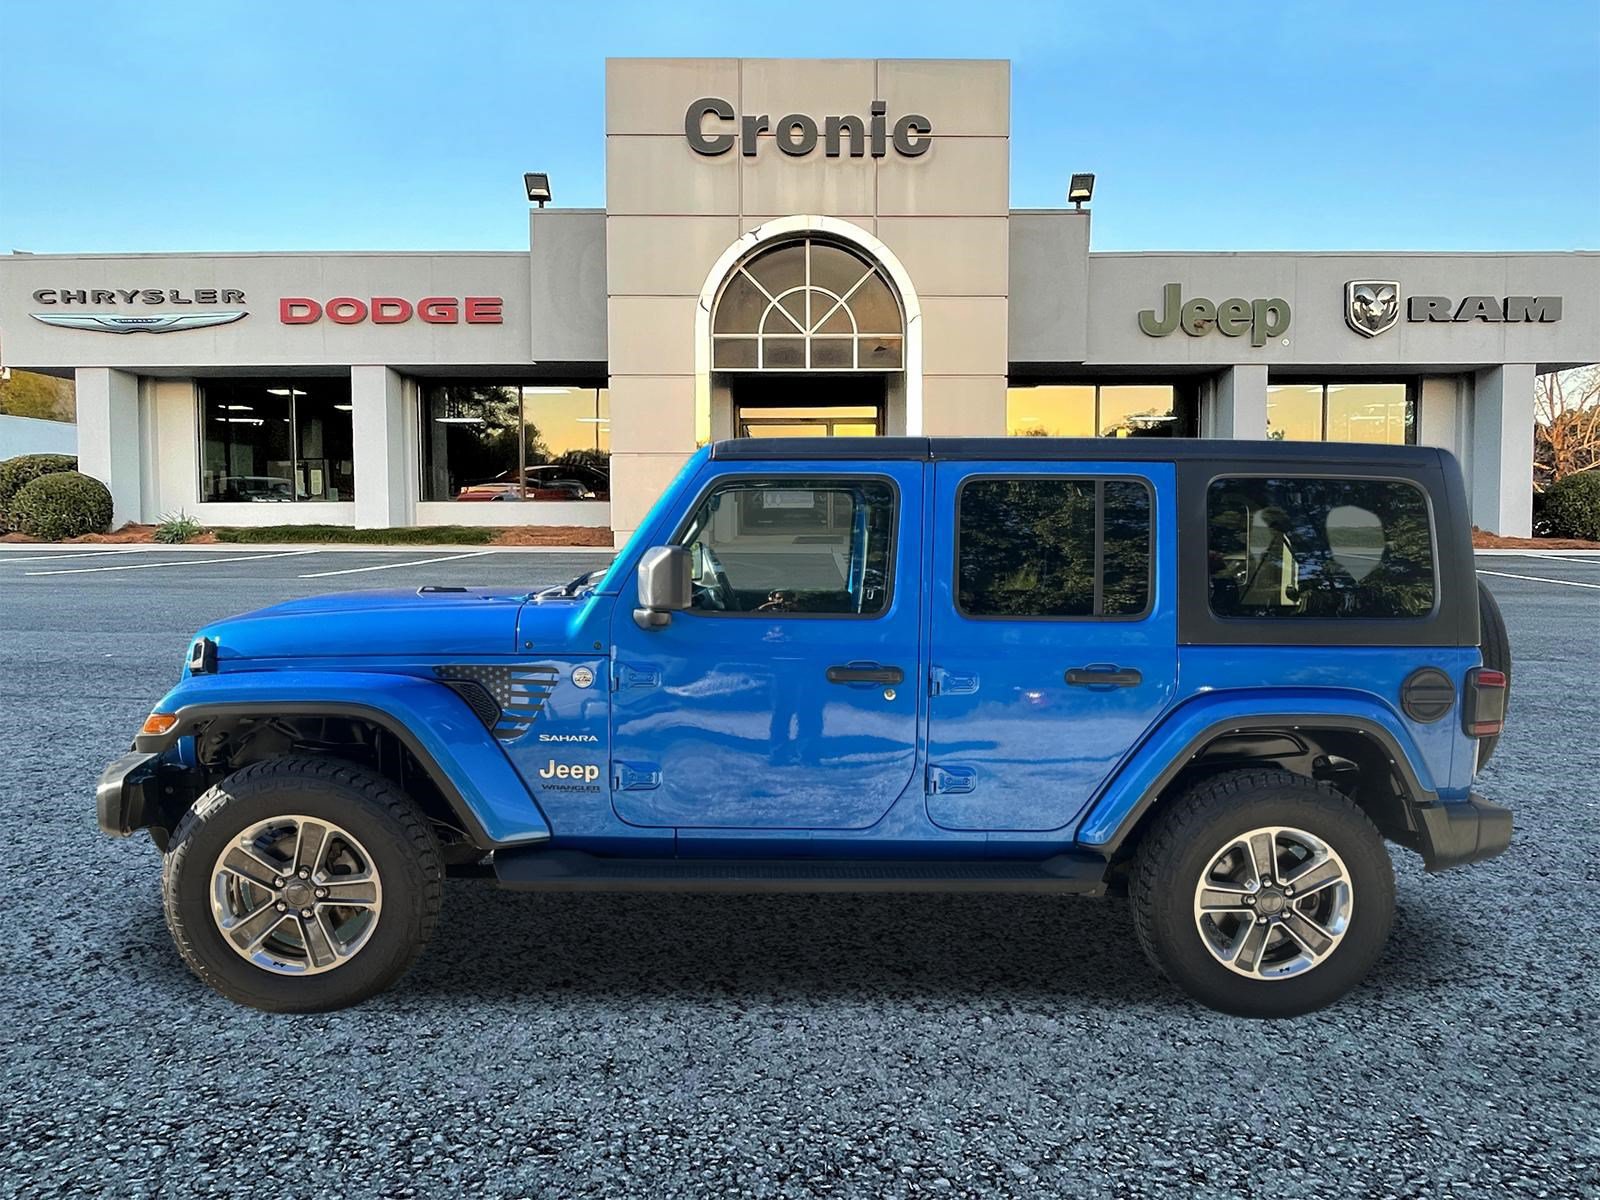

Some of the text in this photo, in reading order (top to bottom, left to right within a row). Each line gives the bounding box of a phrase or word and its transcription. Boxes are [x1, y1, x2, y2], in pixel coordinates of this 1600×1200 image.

[684, 97, 932, 158] Cronic
[32, 288, 246, 305] CHRYSLER
[1407, 296, 1563, 323] RAM
[280, 297, 503, 324] DODGE
[1138, 283, 1291, 347] Jeep
[539, 734, 599, 742] SAHARA
[539, 759, 599, 783] Jeep
